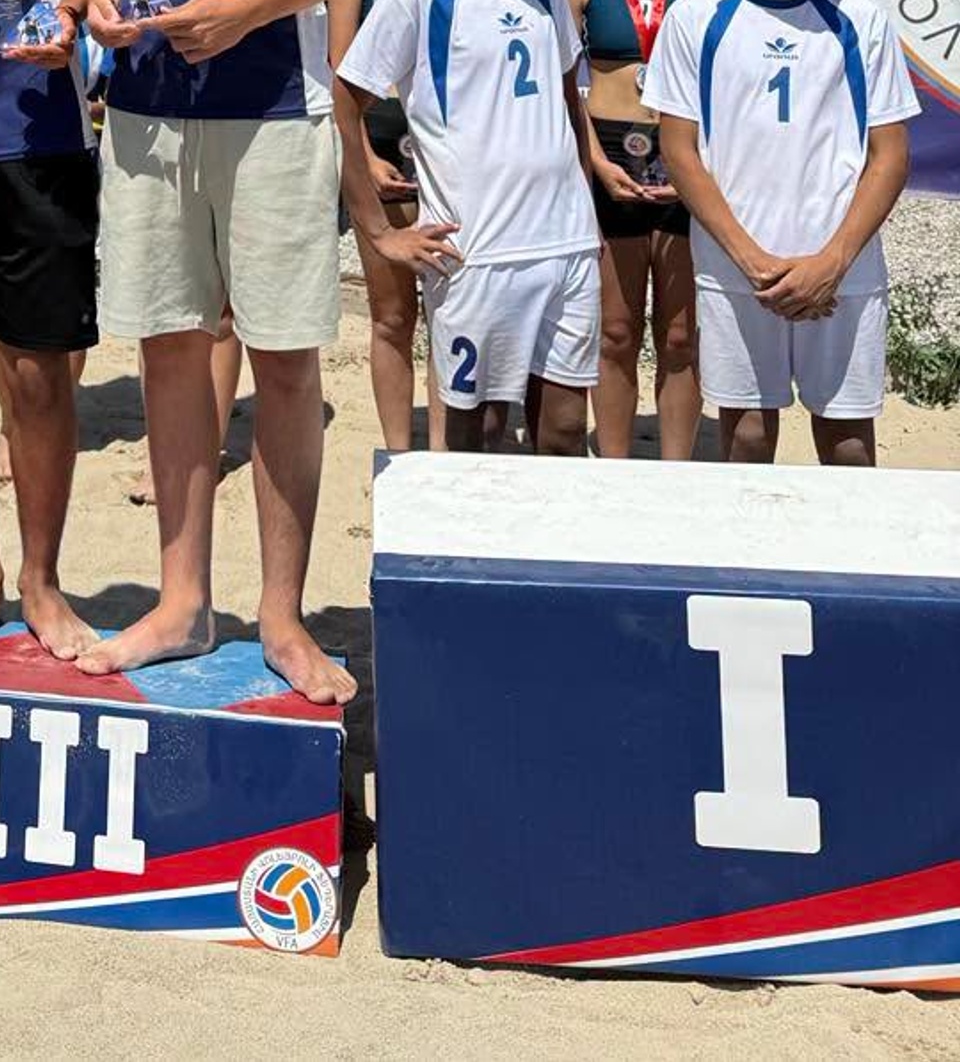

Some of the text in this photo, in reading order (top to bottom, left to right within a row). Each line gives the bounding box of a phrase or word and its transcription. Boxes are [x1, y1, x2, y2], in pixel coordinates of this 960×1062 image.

[508, 38, 540, 97] 2
[767, 66, 790, 123] 1
[451, 335, 478, 394] 2
[686, 594, 821, 854] I
[275, 935, 299, 950] VFA
